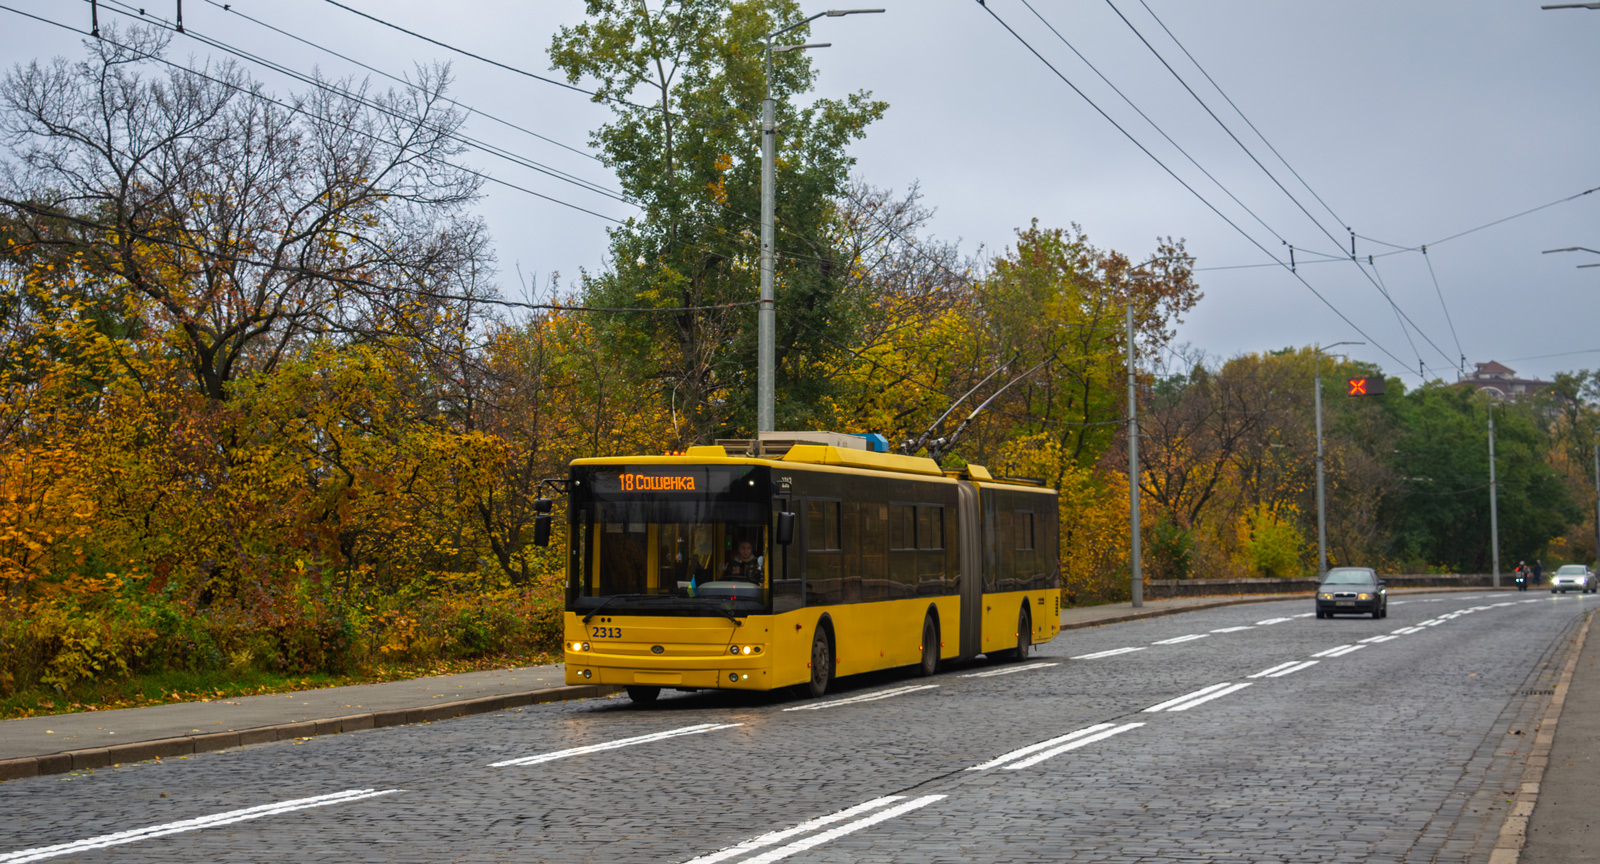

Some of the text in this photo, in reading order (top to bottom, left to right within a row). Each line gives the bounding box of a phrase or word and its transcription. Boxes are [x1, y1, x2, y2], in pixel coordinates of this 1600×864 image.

[619, 473, 696, 491] 18 Сошенка
[592, 626, 622, 638] 2313
